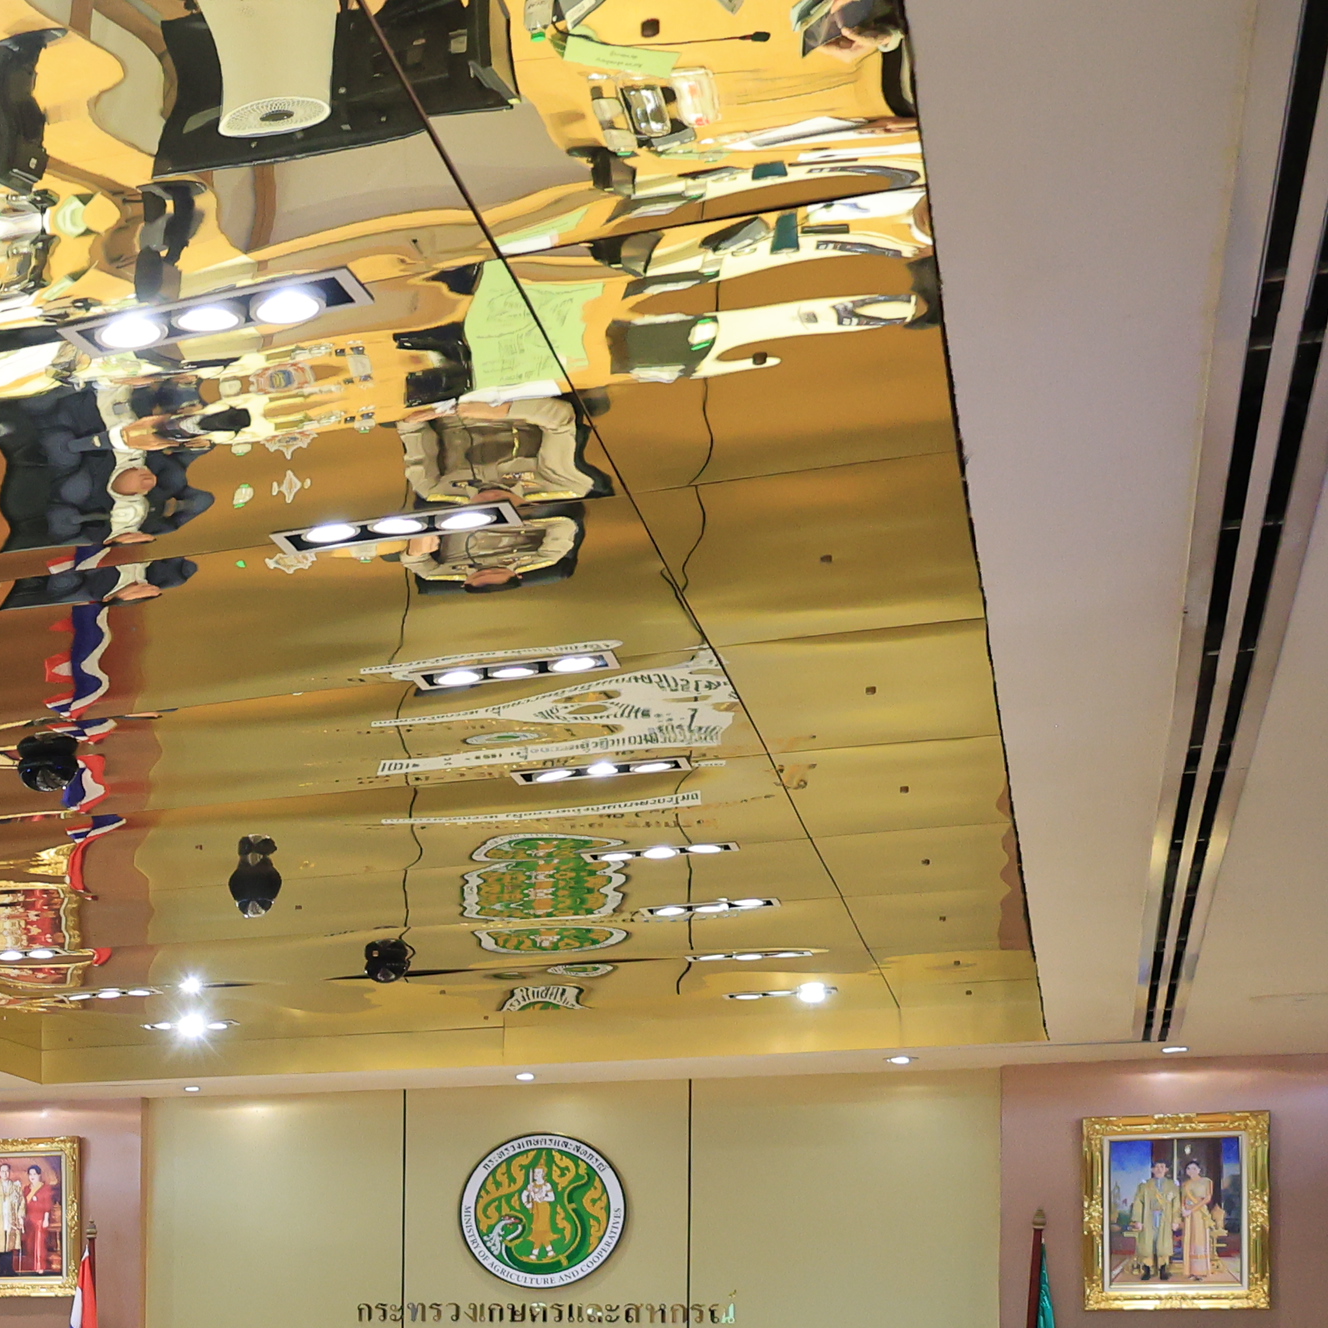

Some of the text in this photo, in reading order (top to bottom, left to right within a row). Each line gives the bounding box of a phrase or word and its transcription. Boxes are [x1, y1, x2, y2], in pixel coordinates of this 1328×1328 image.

[482, 1138, 610, 1173] กระทรวงเกษตรและสหกรณ์
[464, 1205, 622, 1286] MINISTRY OF AGRICULTURE AND COOPERATIVES
[357, 1290, 737, 1325] กระทรวงเกษตรและสหกรณ์
